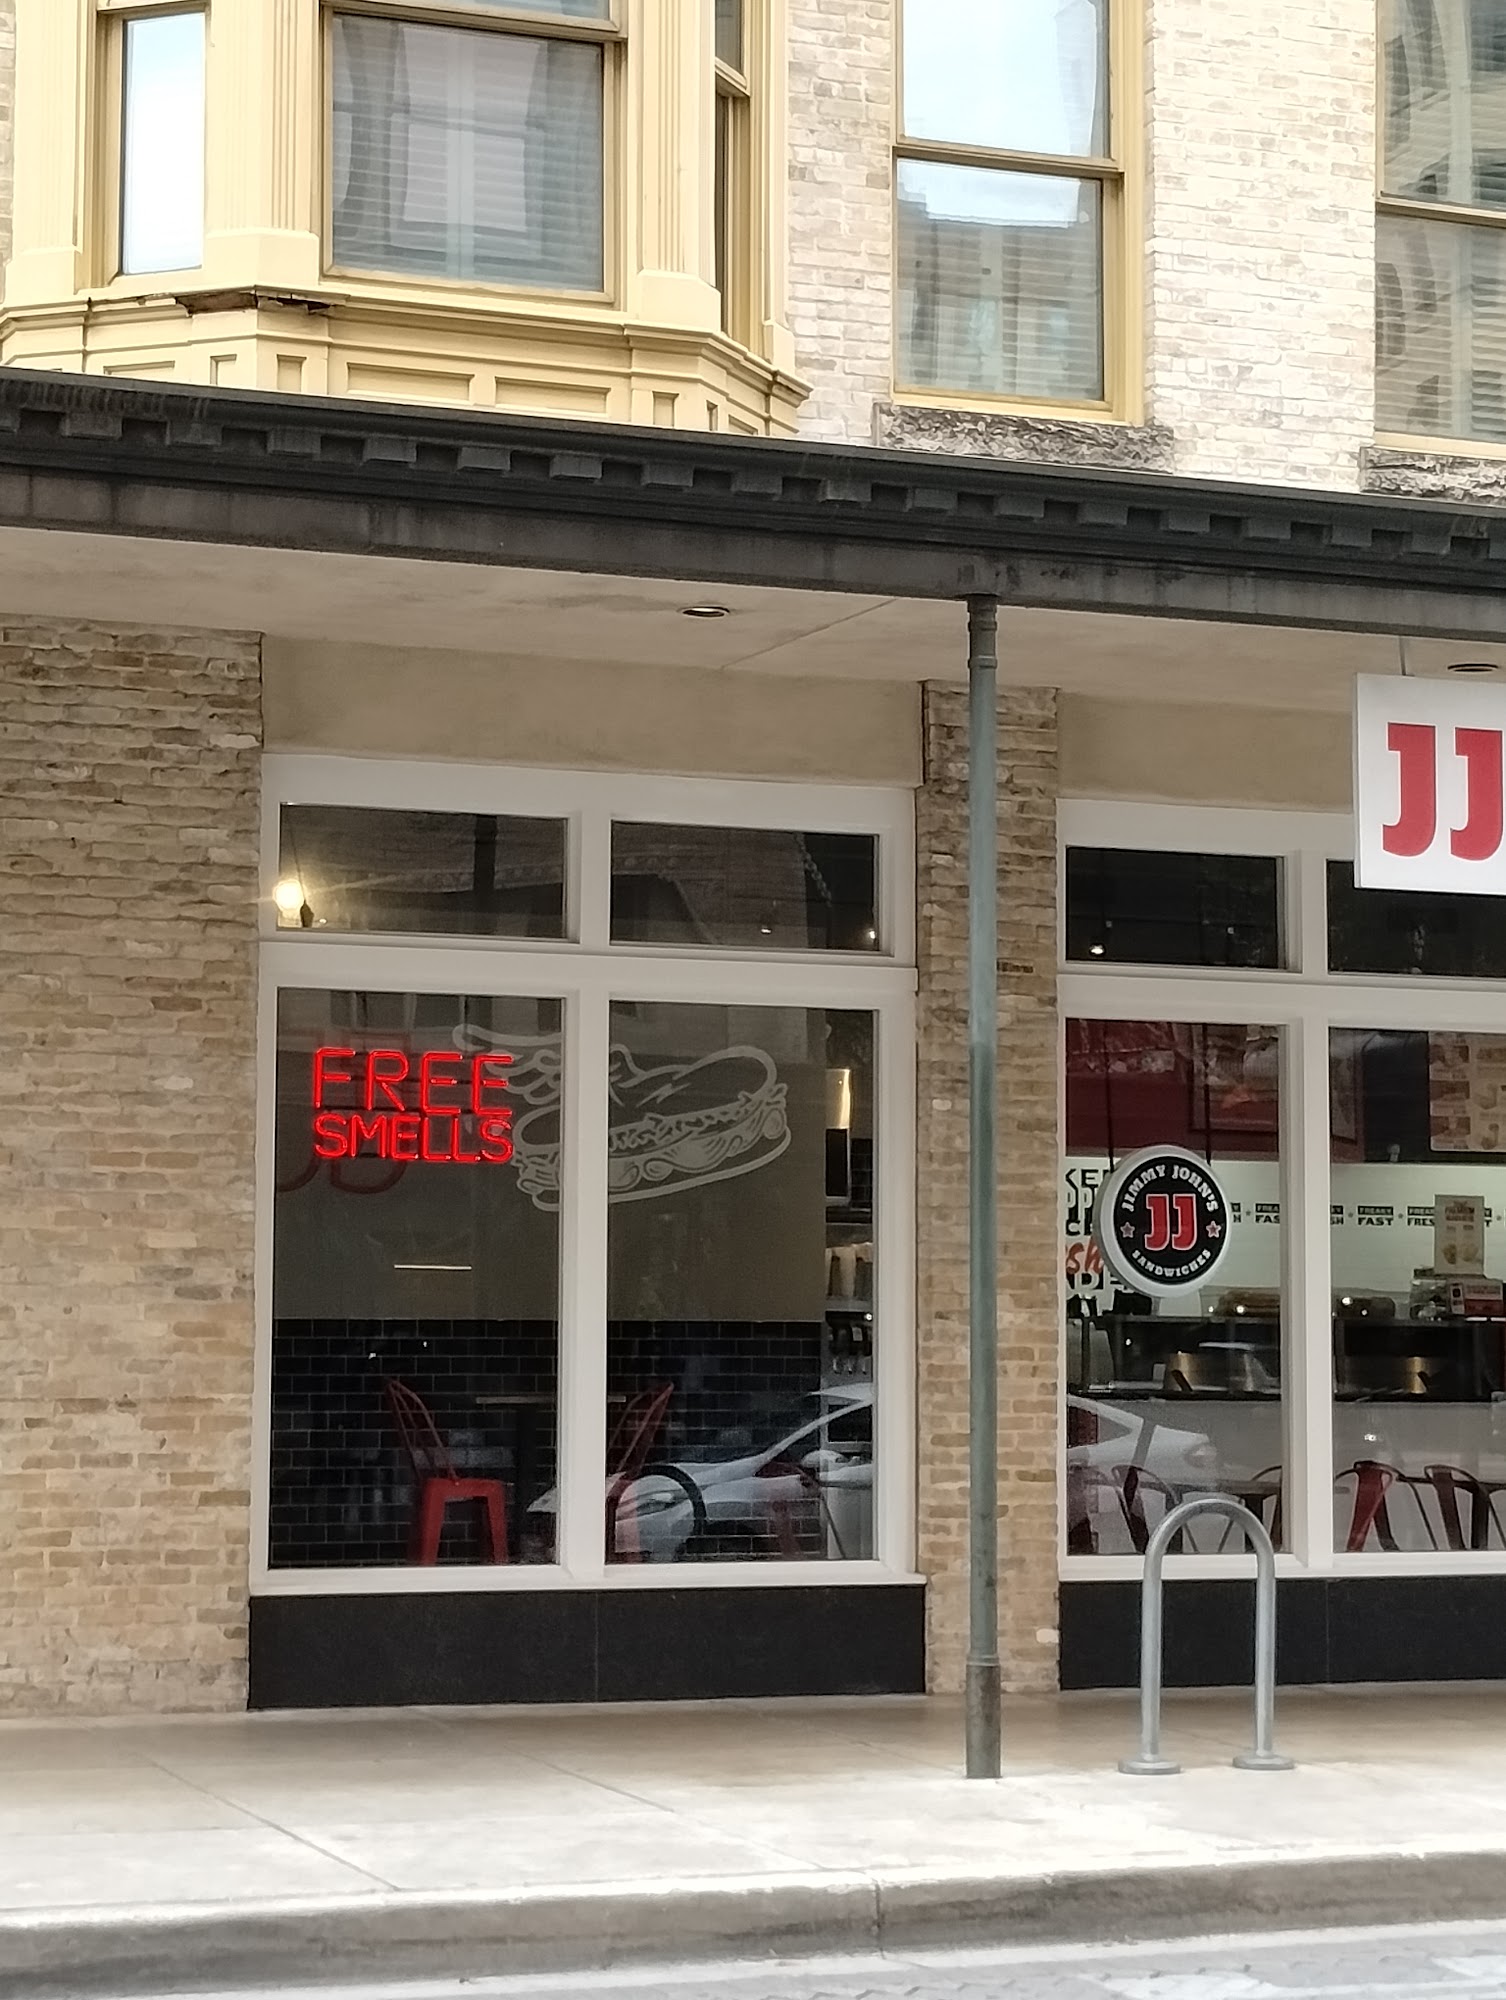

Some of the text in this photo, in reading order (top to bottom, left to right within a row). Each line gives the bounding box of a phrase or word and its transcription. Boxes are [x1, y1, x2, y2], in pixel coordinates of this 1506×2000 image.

[1382, 721, 1505, 861] JJ
[313, 1047, 513, 1117] FREE
[313, 1113, 514, 1163] SMELLS
[1121, 1164, 1166, 1212] JIMMY
[1171, 1164, 1219, 1212] JOHN'S
[1144, 1193, 1198, 1251] JJ
[1255, 1214, 1280, 1224] FAS
[1358, 1216, 1394, 1226] FAST
[1407, 1217, 1436, 1227] FRES
[1132, 1248, 1211, 1277] SANDWICHES
